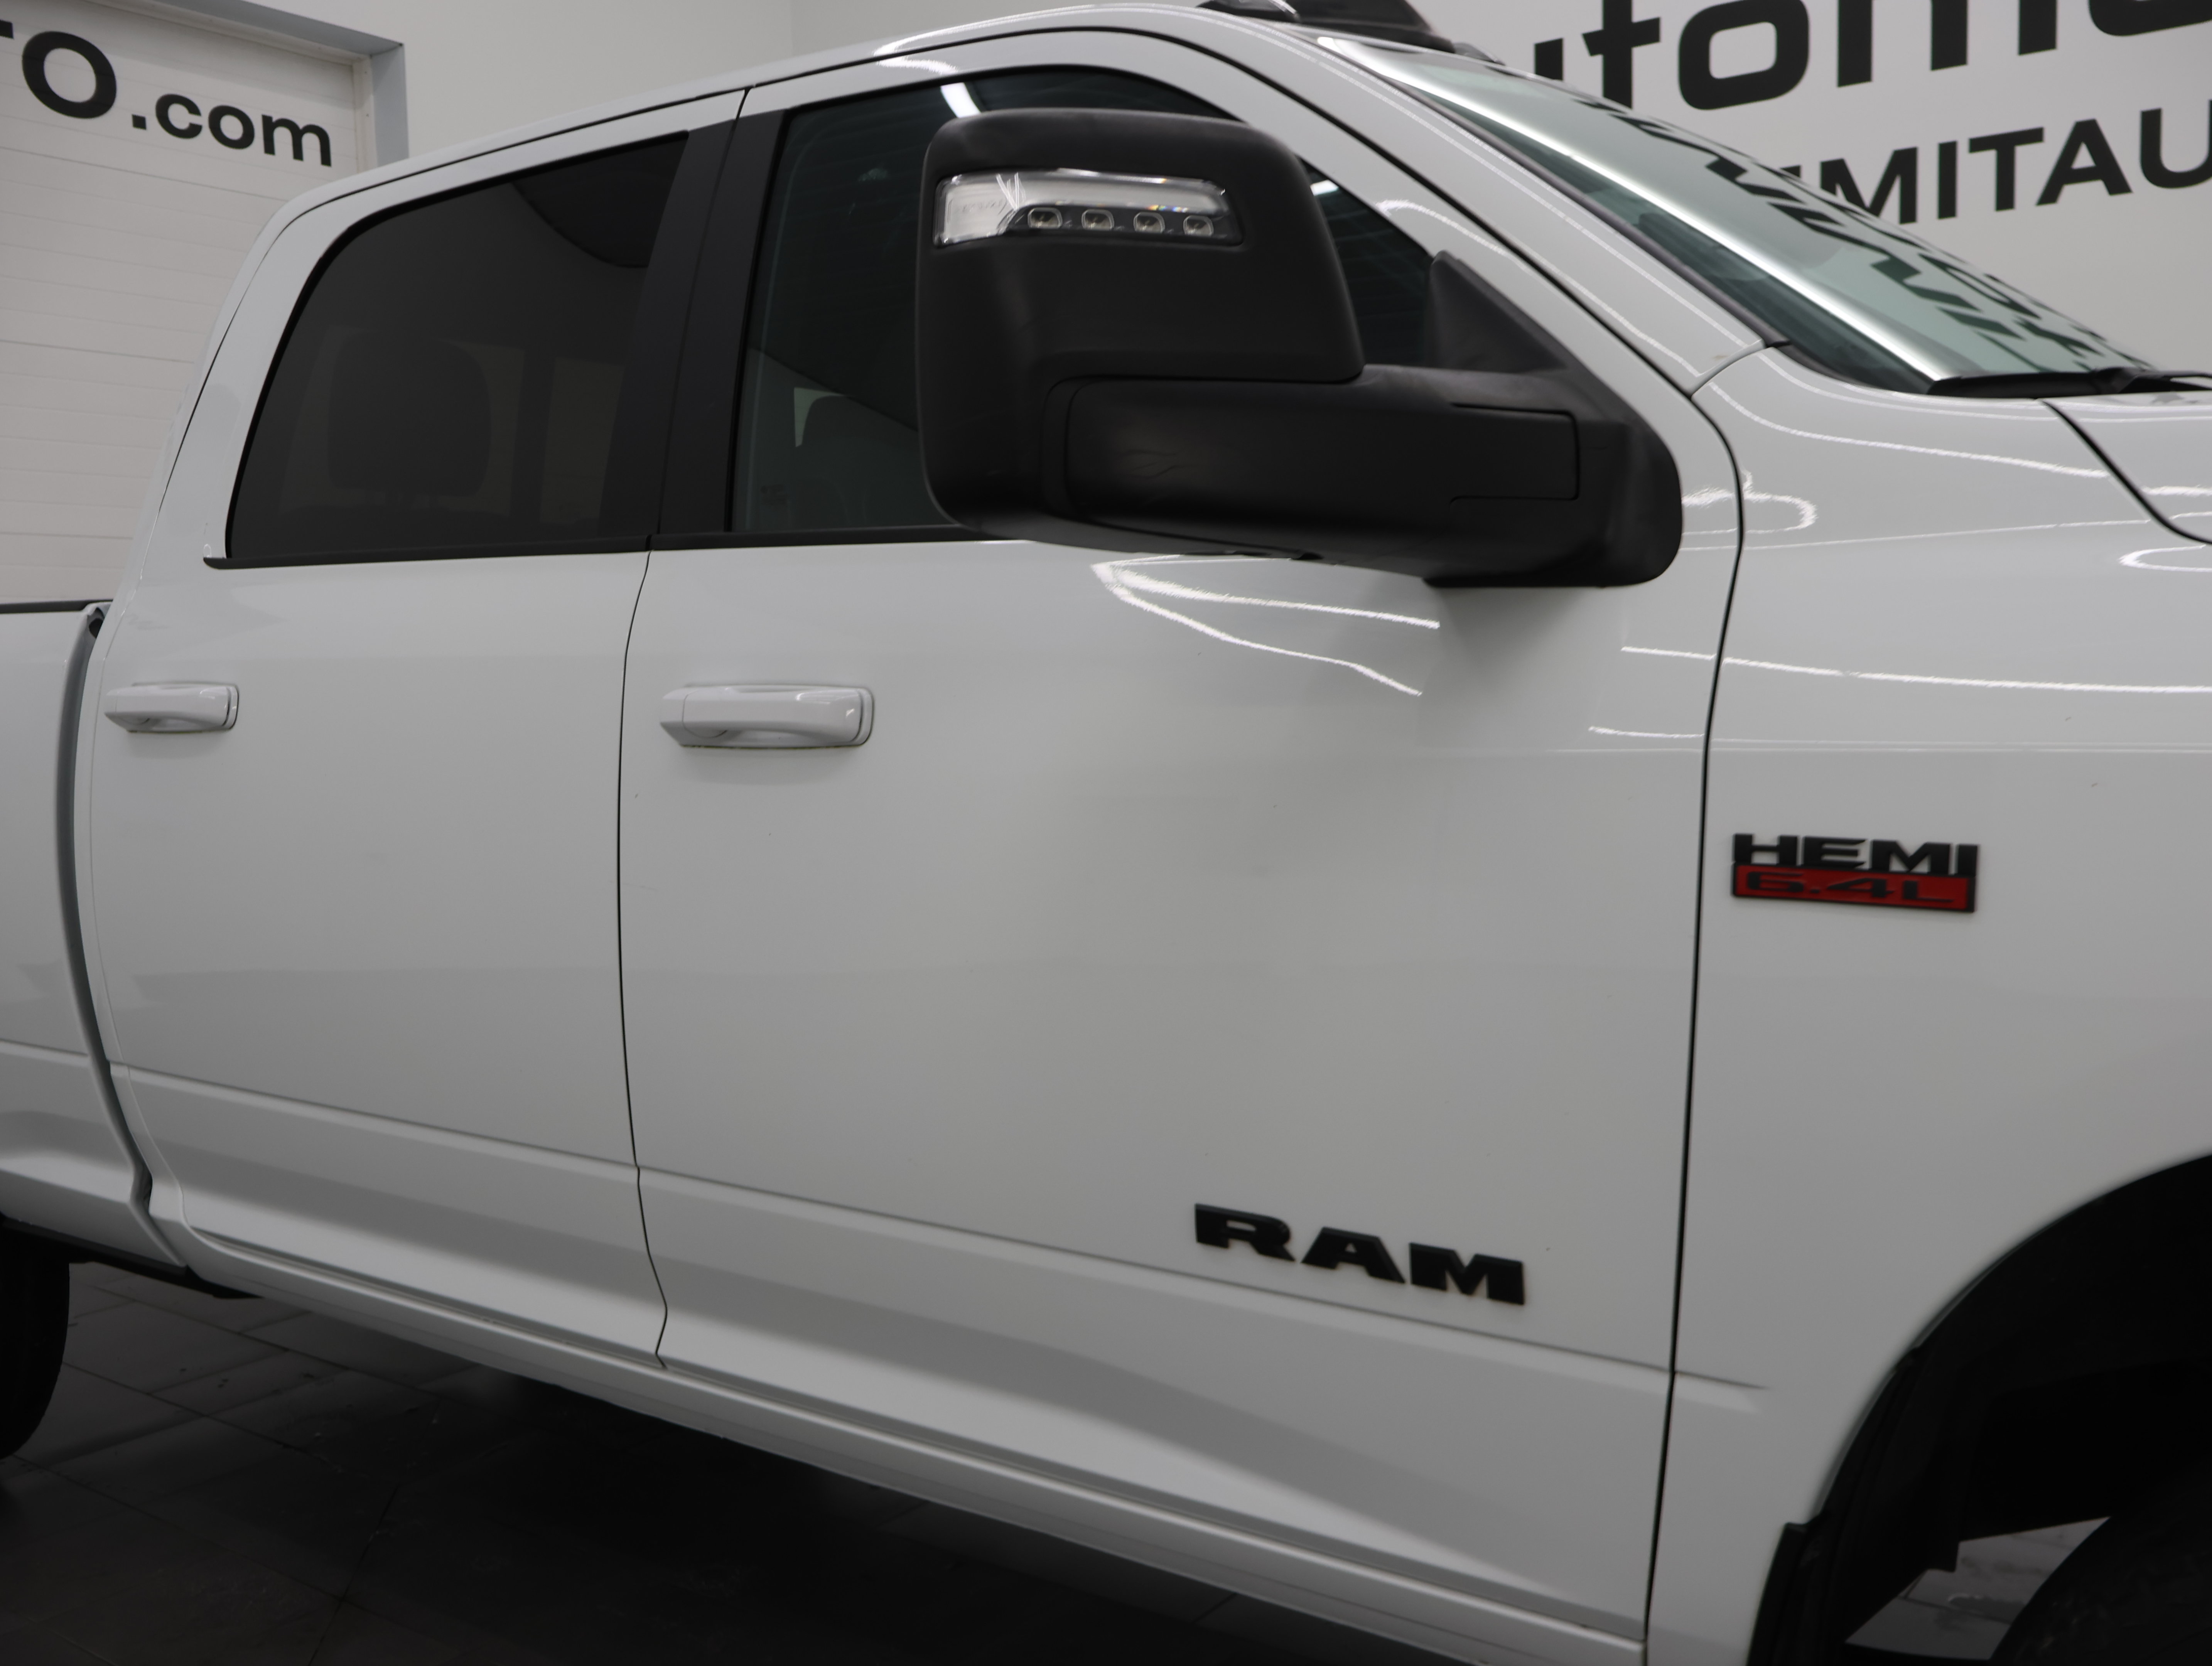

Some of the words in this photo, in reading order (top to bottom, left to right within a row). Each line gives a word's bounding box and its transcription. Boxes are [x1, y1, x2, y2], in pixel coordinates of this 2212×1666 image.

[1780, 99, 2212, 224] MITAU
[1733, 833, 1979, 875] HEMI
[1746, 871, 1955, 903] 6.4L
[1195, 1203, 1525, 1305] RAM
